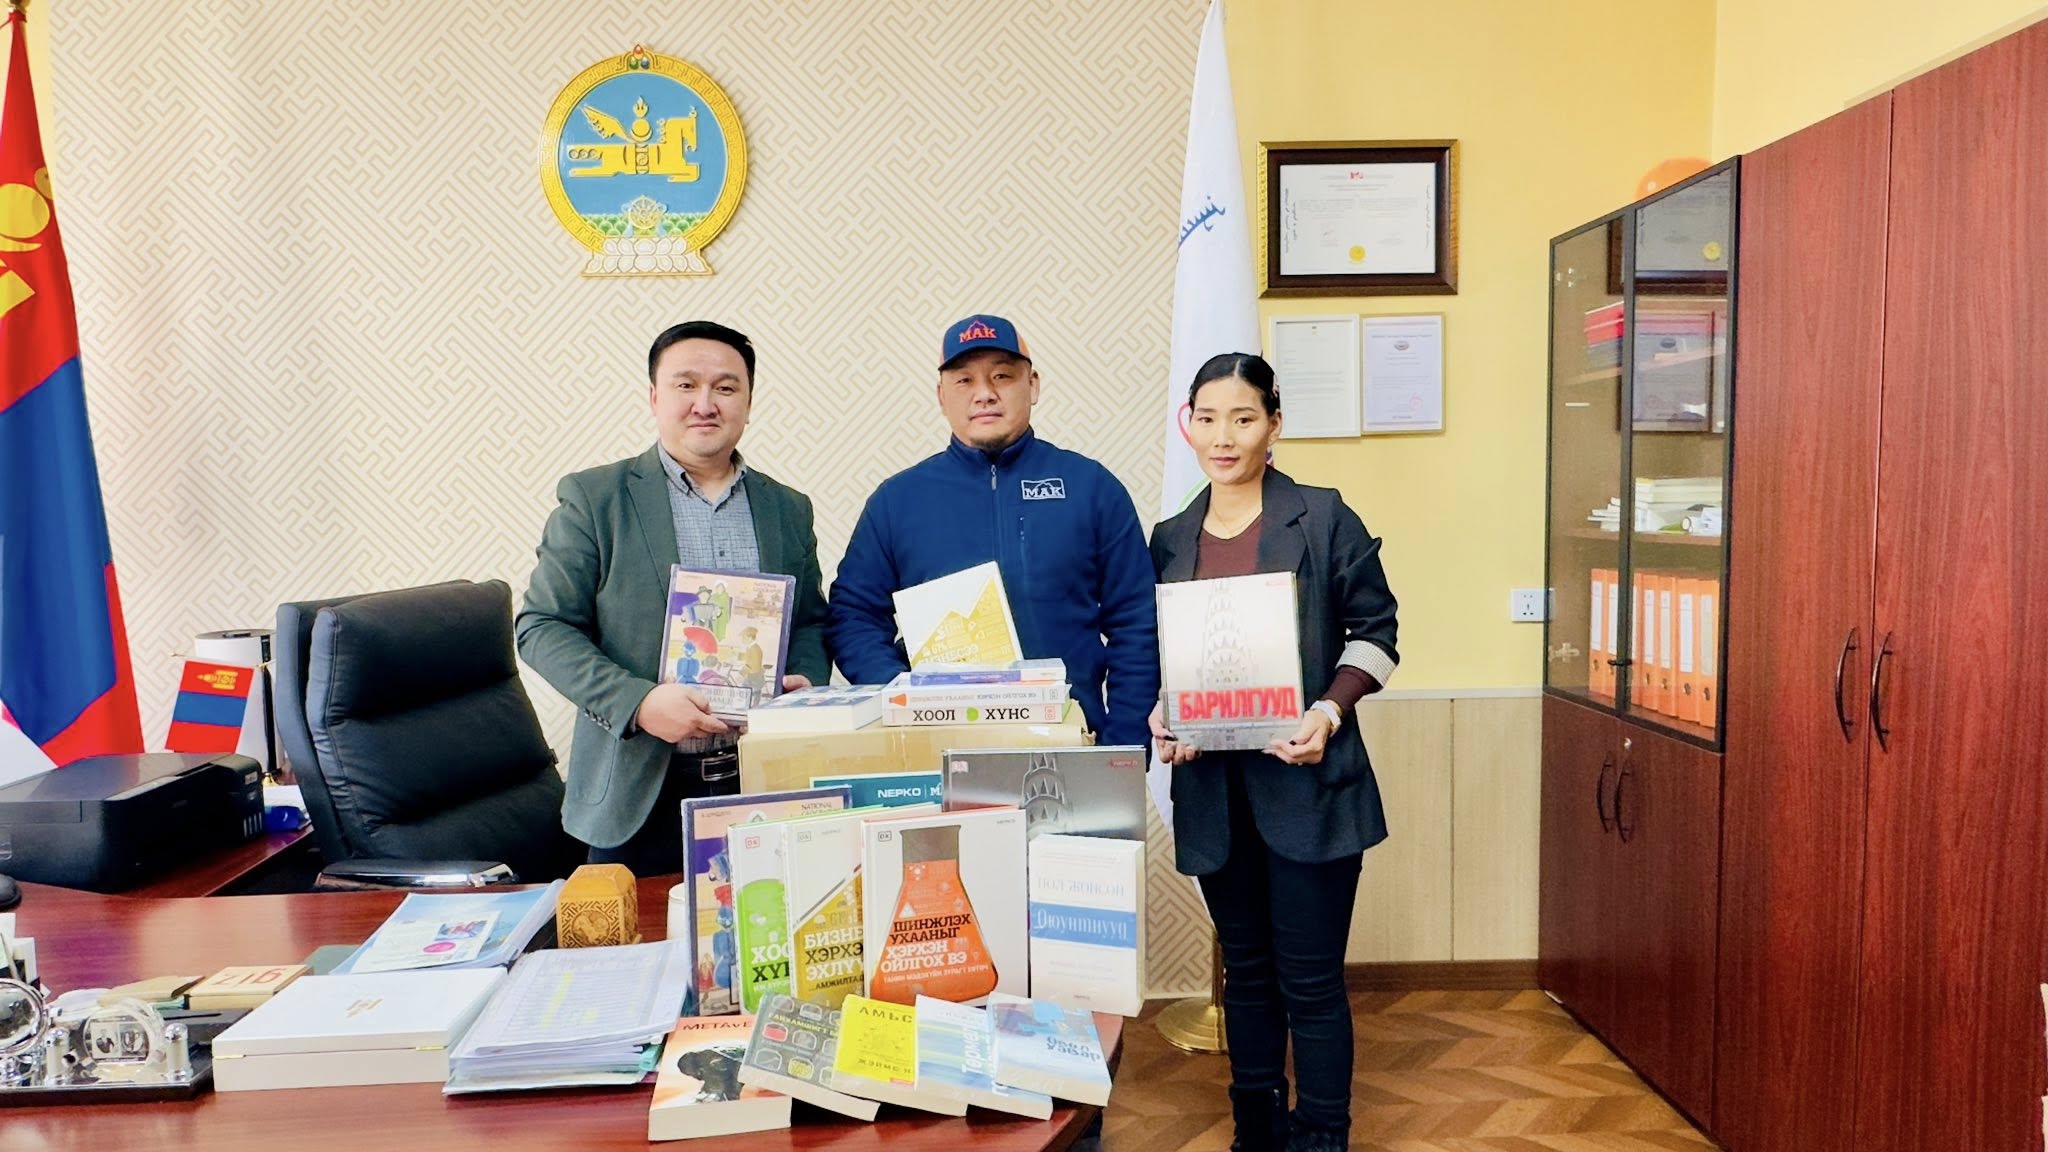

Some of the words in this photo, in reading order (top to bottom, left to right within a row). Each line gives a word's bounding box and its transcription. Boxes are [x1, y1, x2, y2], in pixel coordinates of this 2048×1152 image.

[959, 327, 997, 344] MAK
[1024, 485, 1063, 498] MAK
[1178, 687, 1298, 721] БАРИЛГУУД
[913, 709, 955, 722] ХООЛ
[985, 707, 1030, 720] ХҮНС
[877, 787, 921, 798] NEPKO
[893, 913, 971, 932] ШИНЖЛЭХ
[890, 927, 960, 944] УХААНЫГ
[805, 943, 863, 965] ХЭРХЭ
[886, 941, 948, 959] ХЭРХЭН
[880, 954, 945, 973] ОЙЛГОХ
[947, 951, 968, 965] ВЭ
